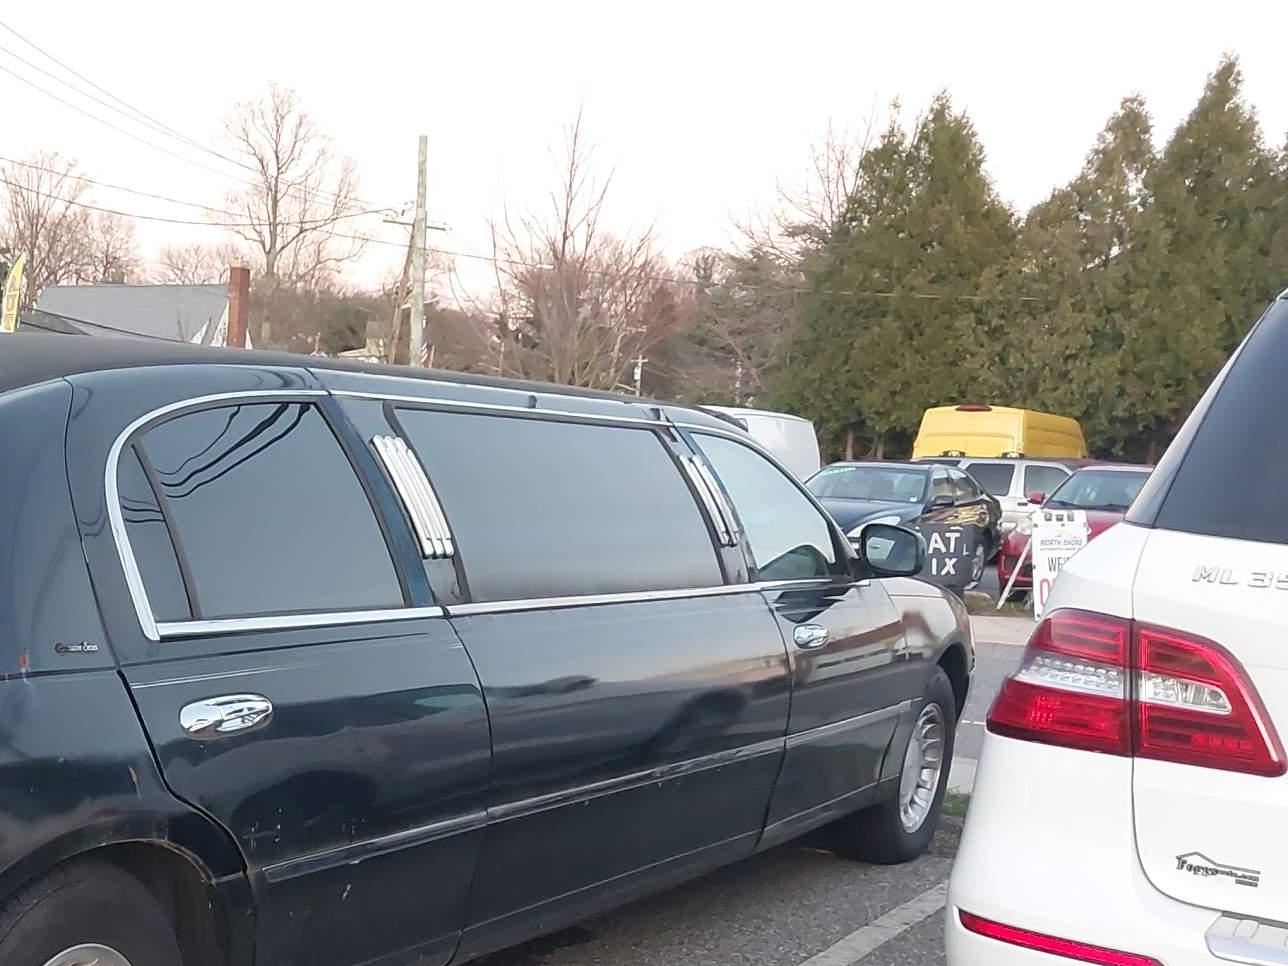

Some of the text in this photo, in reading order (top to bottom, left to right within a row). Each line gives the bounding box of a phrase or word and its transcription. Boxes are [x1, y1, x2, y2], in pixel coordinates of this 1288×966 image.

[928, 532, 960, 554] AT
[932, 557, 958, 575] IX
[1191, 565, 1239, 585] ML
